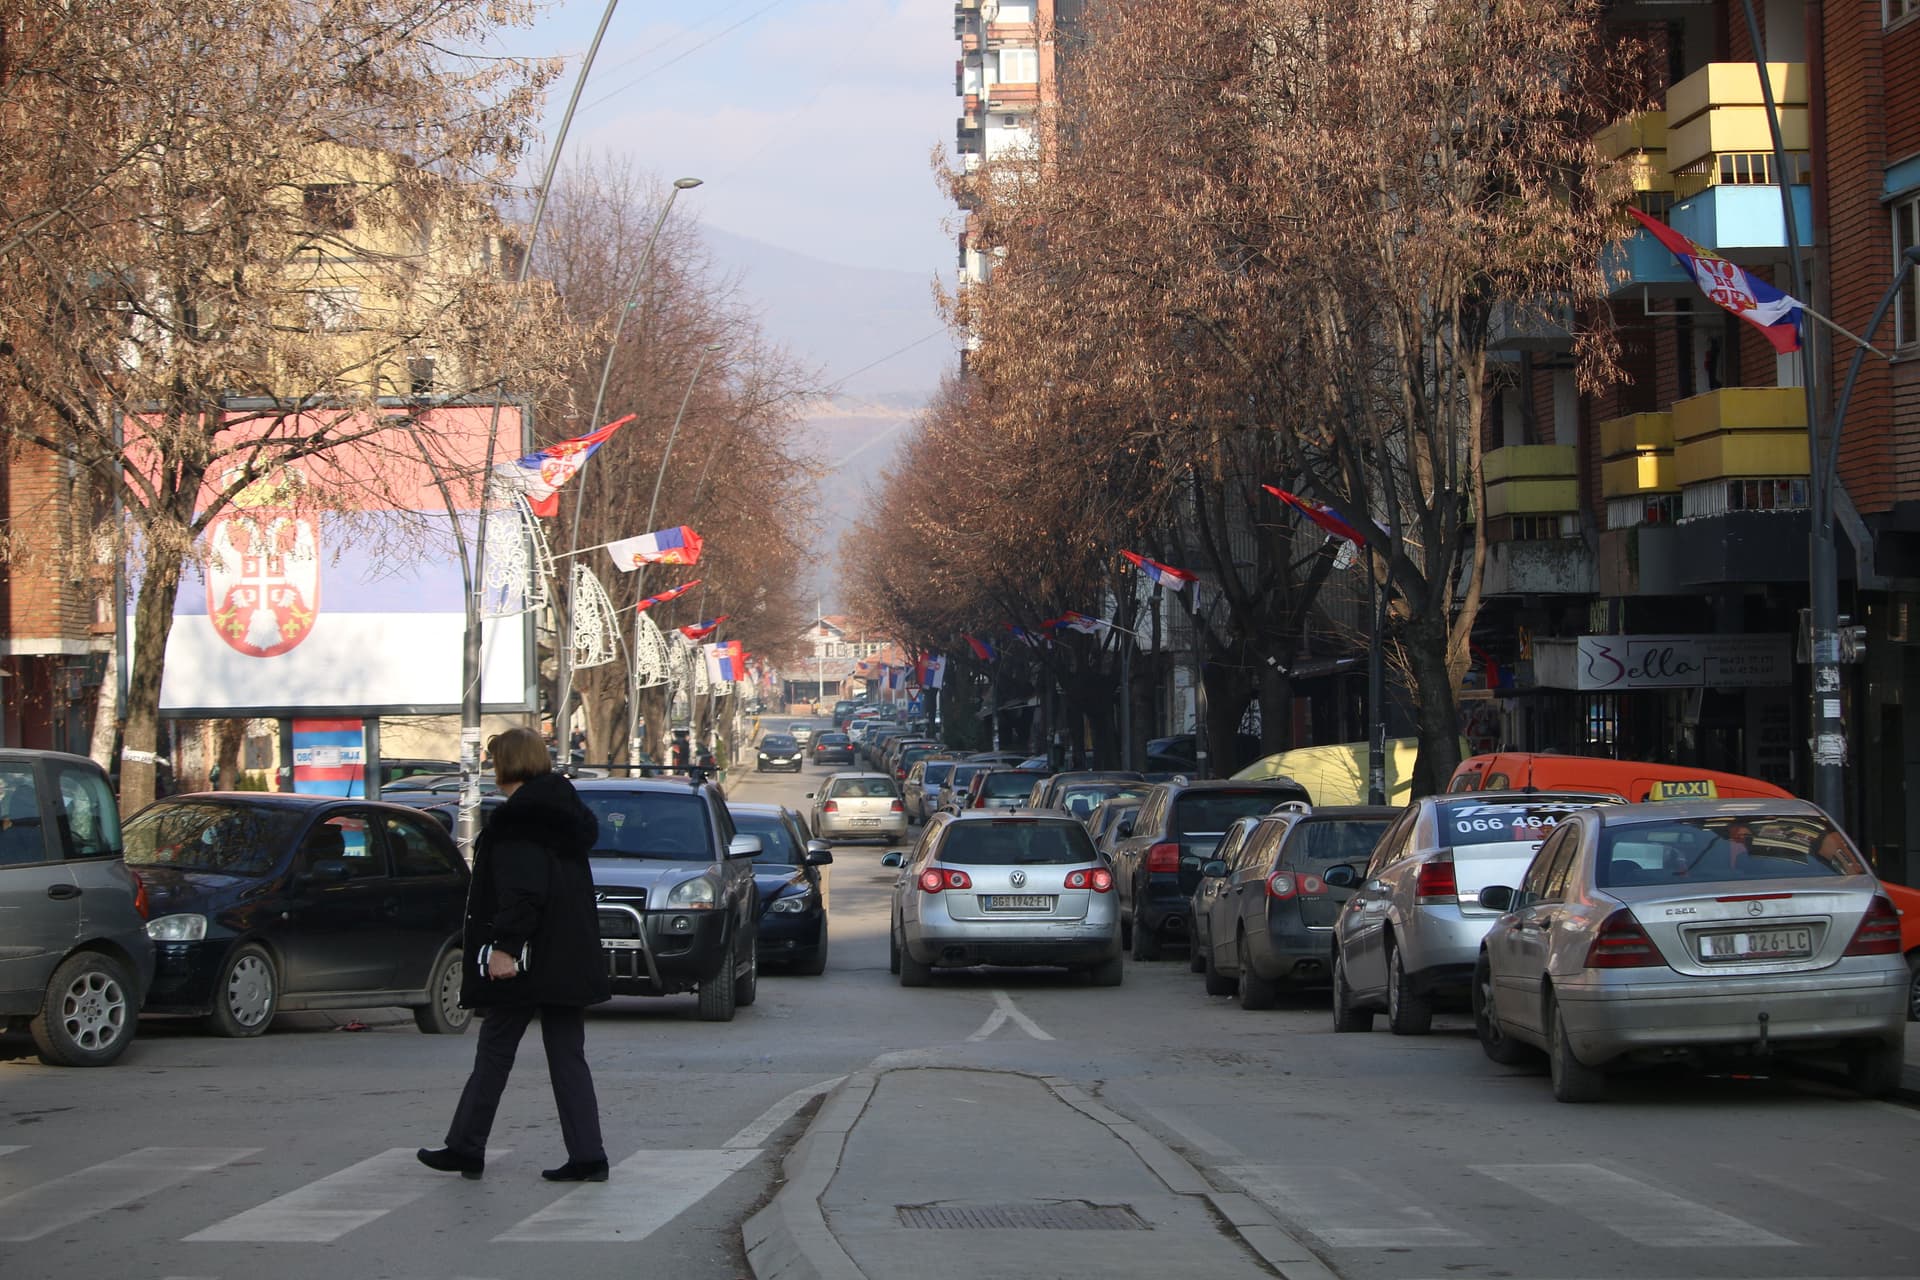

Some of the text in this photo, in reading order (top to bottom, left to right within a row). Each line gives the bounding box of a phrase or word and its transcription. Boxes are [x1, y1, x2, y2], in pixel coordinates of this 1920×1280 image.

[1579, 640, 1701, 688] Bella
[1663, 782, 1708, 796] TAXI
[1456, 816, 1558, 833] 066 464
